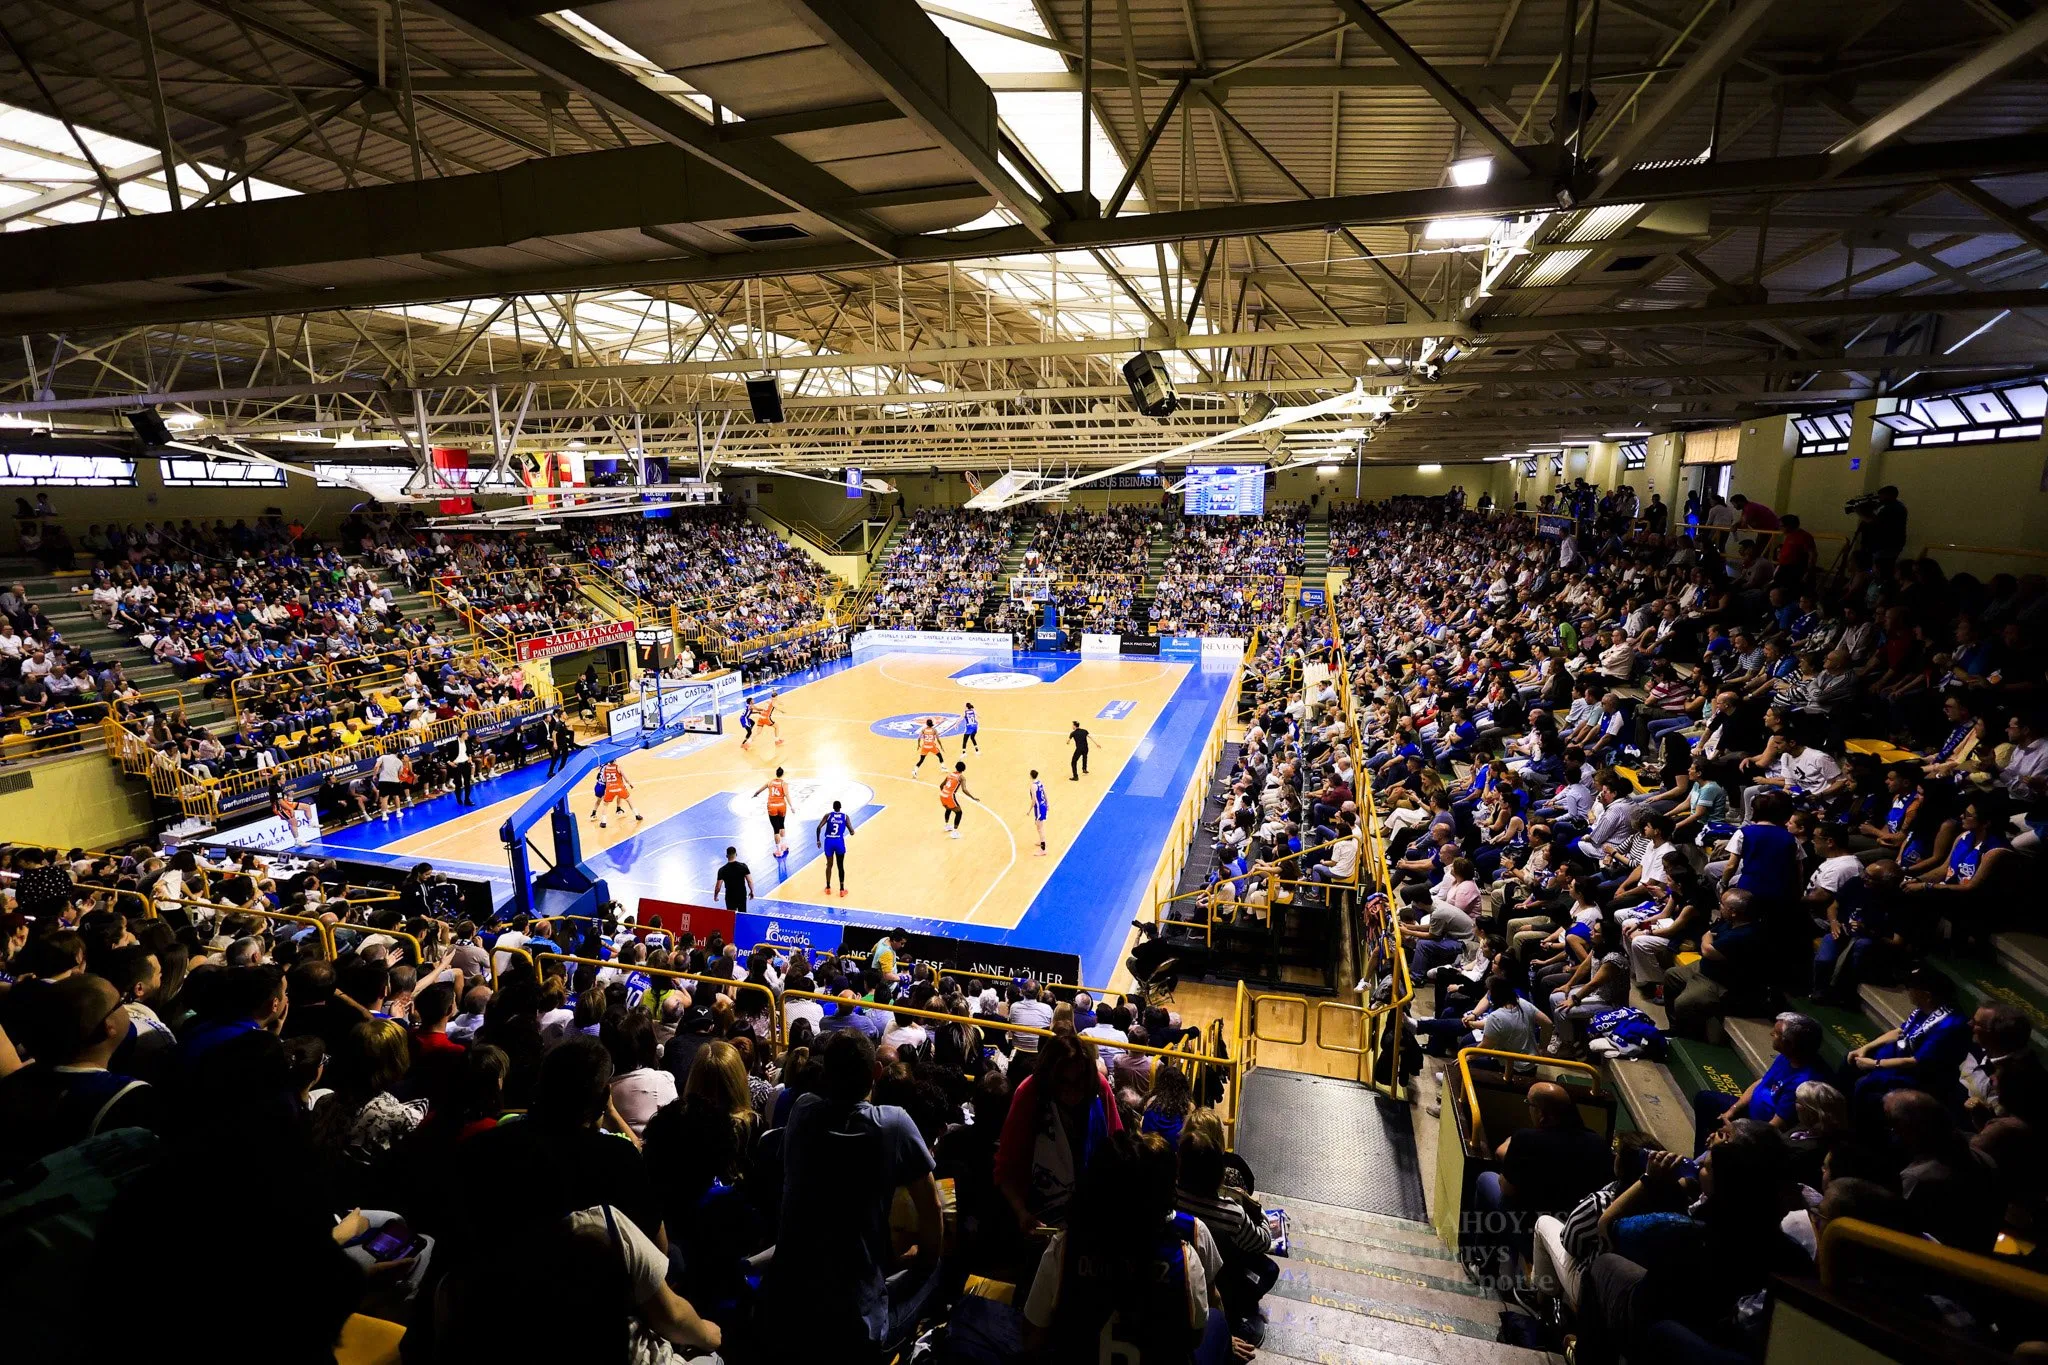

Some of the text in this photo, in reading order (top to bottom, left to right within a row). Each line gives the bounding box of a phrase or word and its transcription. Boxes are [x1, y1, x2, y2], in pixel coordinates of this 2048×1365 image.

[1099, 477, 1117, 488] SUS
[1119, 476, 1151, 488] REINAS
[545, 624, 623, 647] SALAMANCA
[532, 630, 633, 658] PATRIMONIO DE LA HUMANIDAD
[1203, 642, 1242, 651] REVLON
[641, 645, 652, 660] 7
[661, 643, 671, 659] 7
[722, 675, 737, 687] LEÓN
[661, 693, 678, 707] LEÓN
[605, 772, 618, 782] 23
[771, 786, 781, 796] 14
[269, 827, 277, 838] Y
[830, 823, 839, 836] 3
[969, 962, 1005, 978] ANNE
